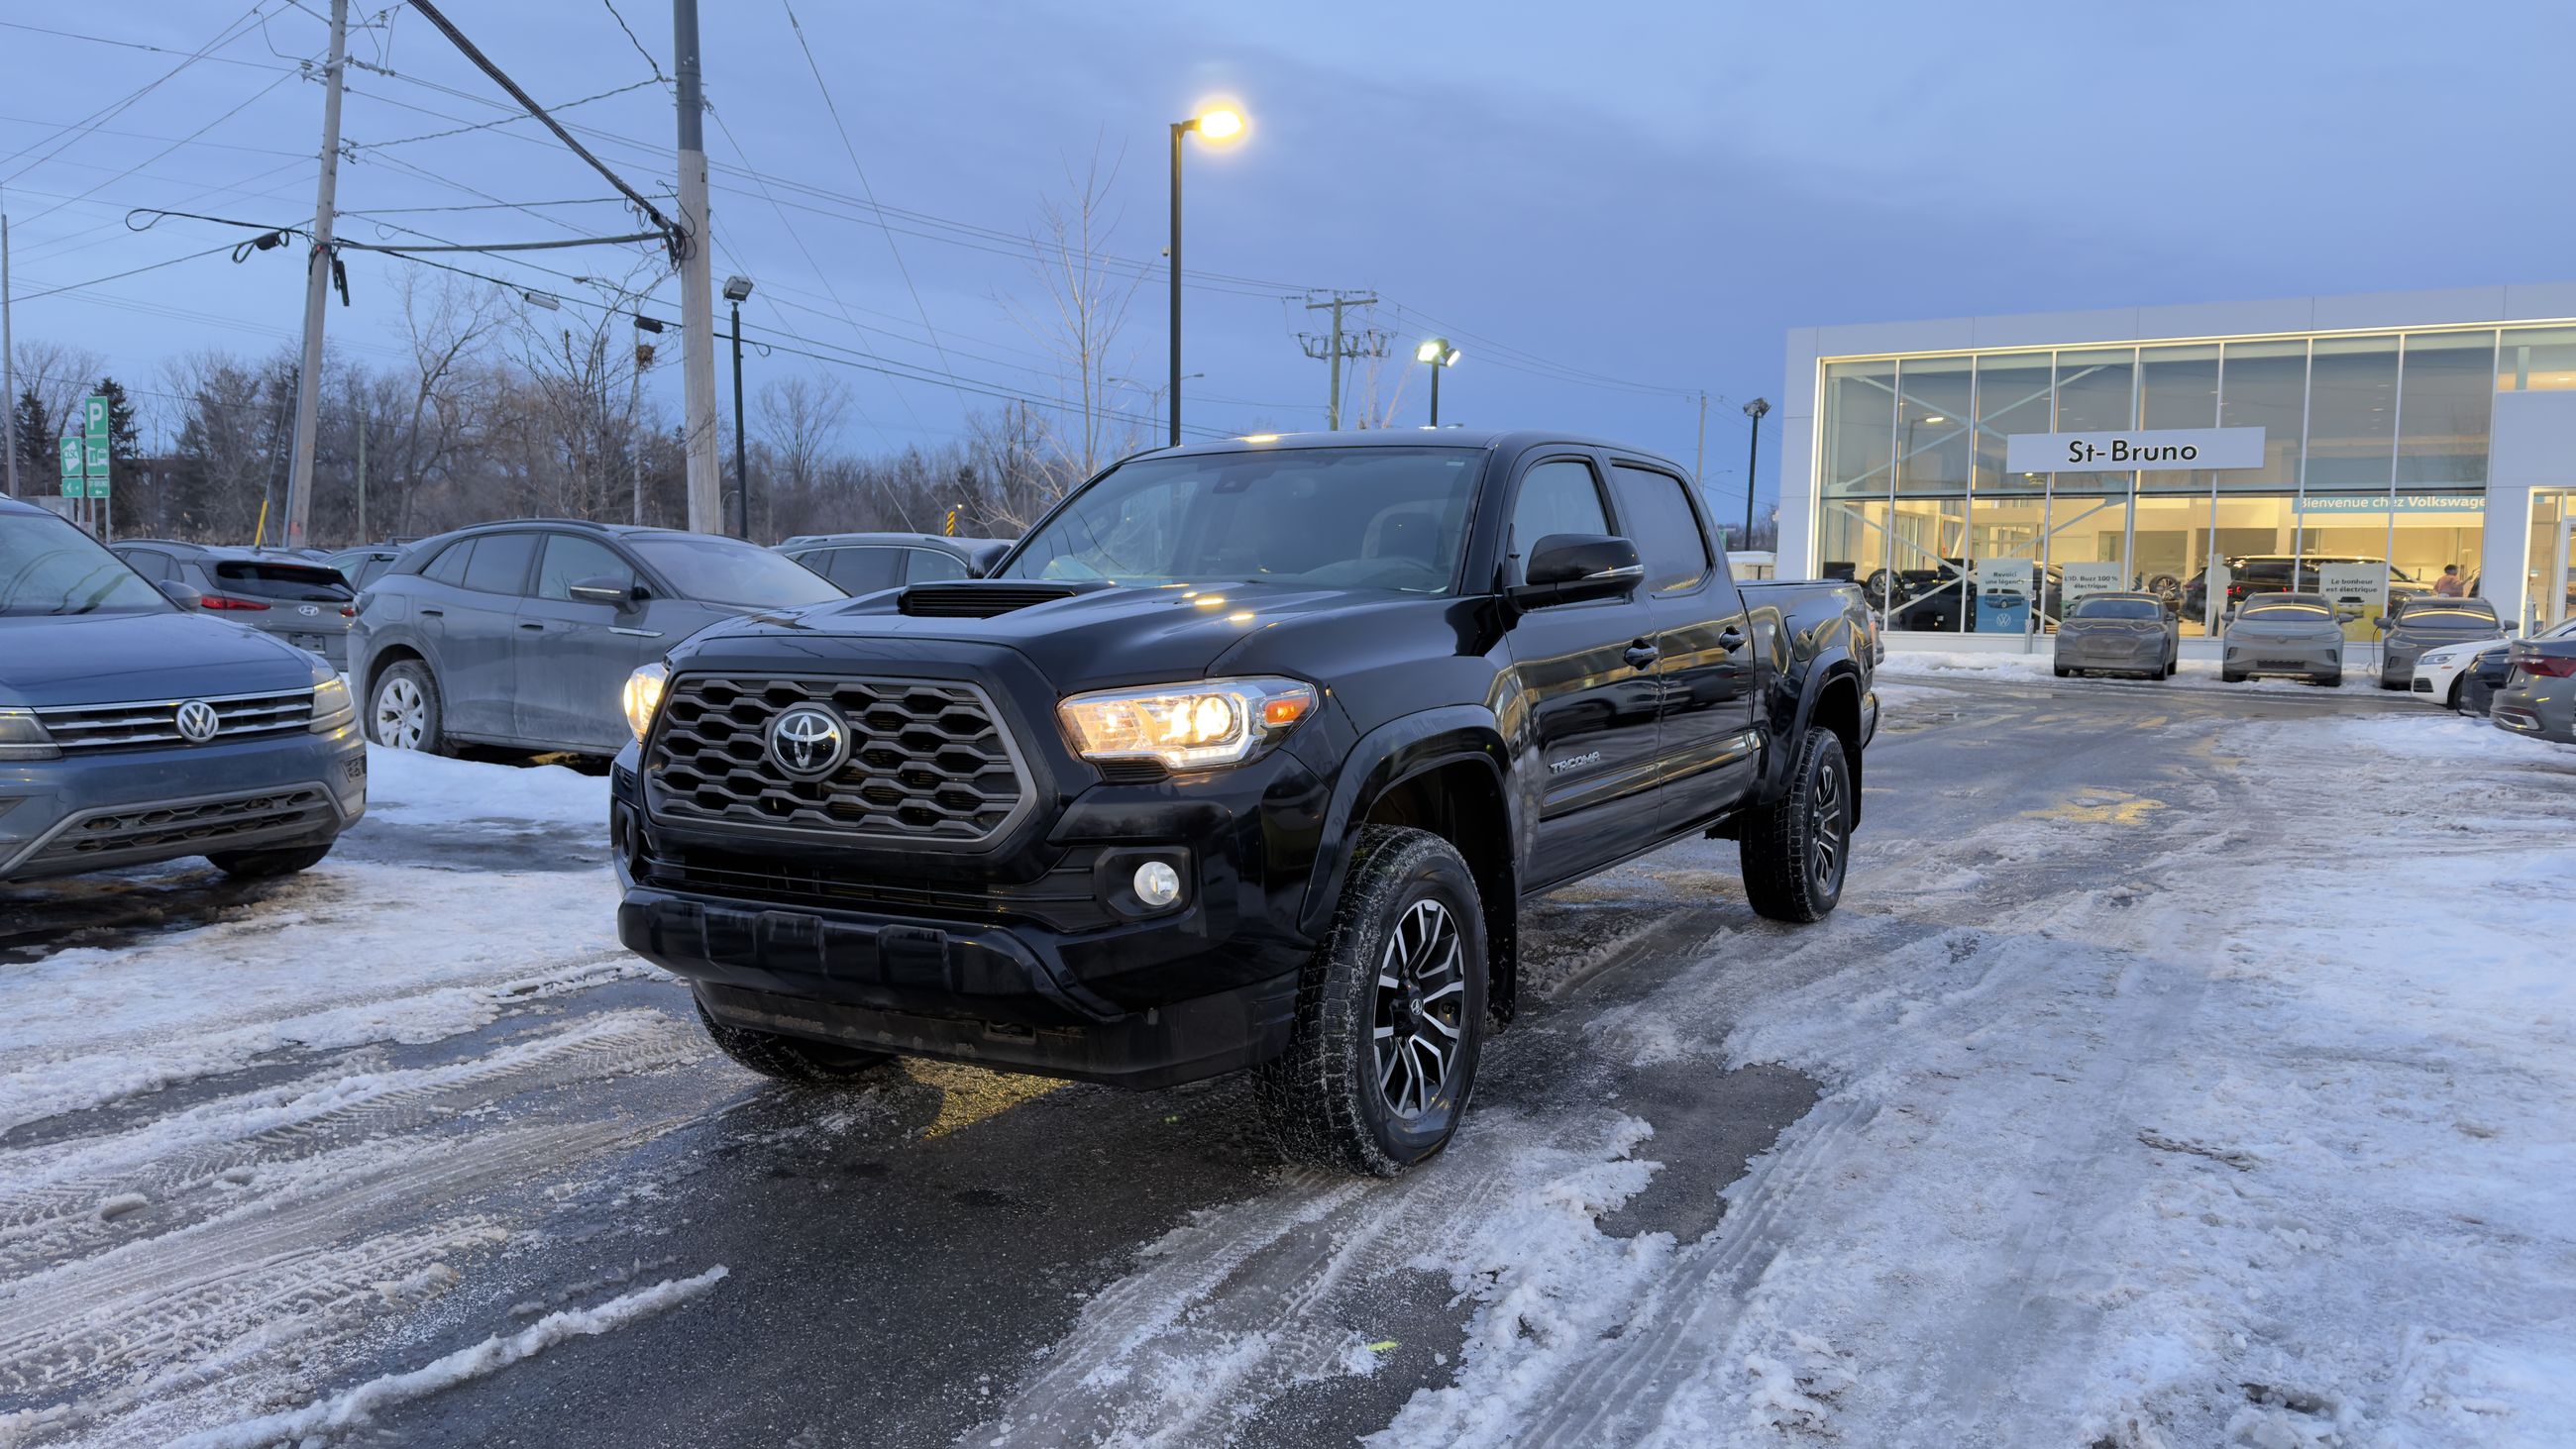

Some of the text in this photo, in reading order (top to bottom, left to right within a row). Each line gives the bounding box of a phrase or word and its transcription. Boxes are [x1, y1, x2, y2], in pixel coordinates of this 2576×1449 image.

[89, 402, 104, 431] P
[2068, 439, 2199, 464] St-Bruno
[2408, 496, 2486, 509] Volkswage
[1550, 751, 1601, 774] TACOMA
